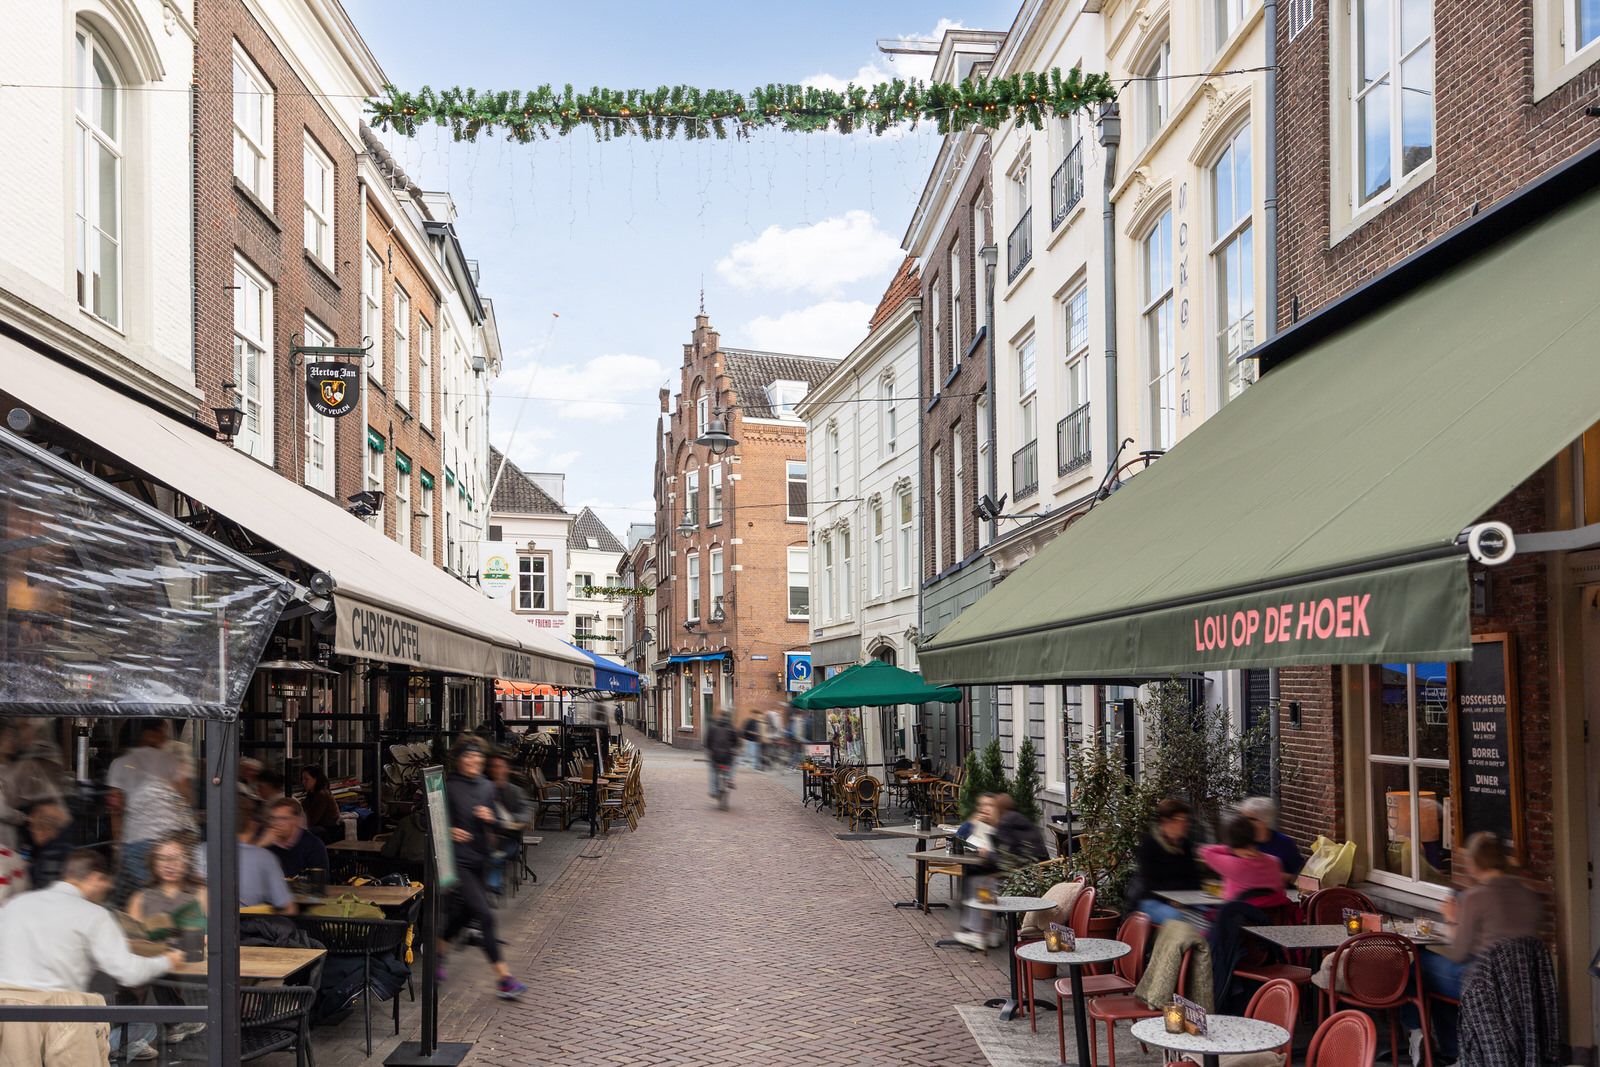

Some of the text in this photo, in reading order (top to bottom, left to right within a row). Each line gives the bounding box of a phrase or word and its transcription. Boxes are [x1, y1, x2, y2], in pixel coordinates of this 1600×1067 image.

[310, 366, 356, 379] Hertog Jan
[315, 403, 351, 415] HET VEULEN
[1194, 593, 1371, 652] LOU OP DE HOEK
[352, 607, 421, 662] CHRISTOFFEL
[1461, 695, 1506, 705] BOSSCHE BOL
[1472, 722, 1496, 732] LUNCH
[1472, 748, 1500, 758] BORREL
[1475, 775, 1499, 786] DINER
